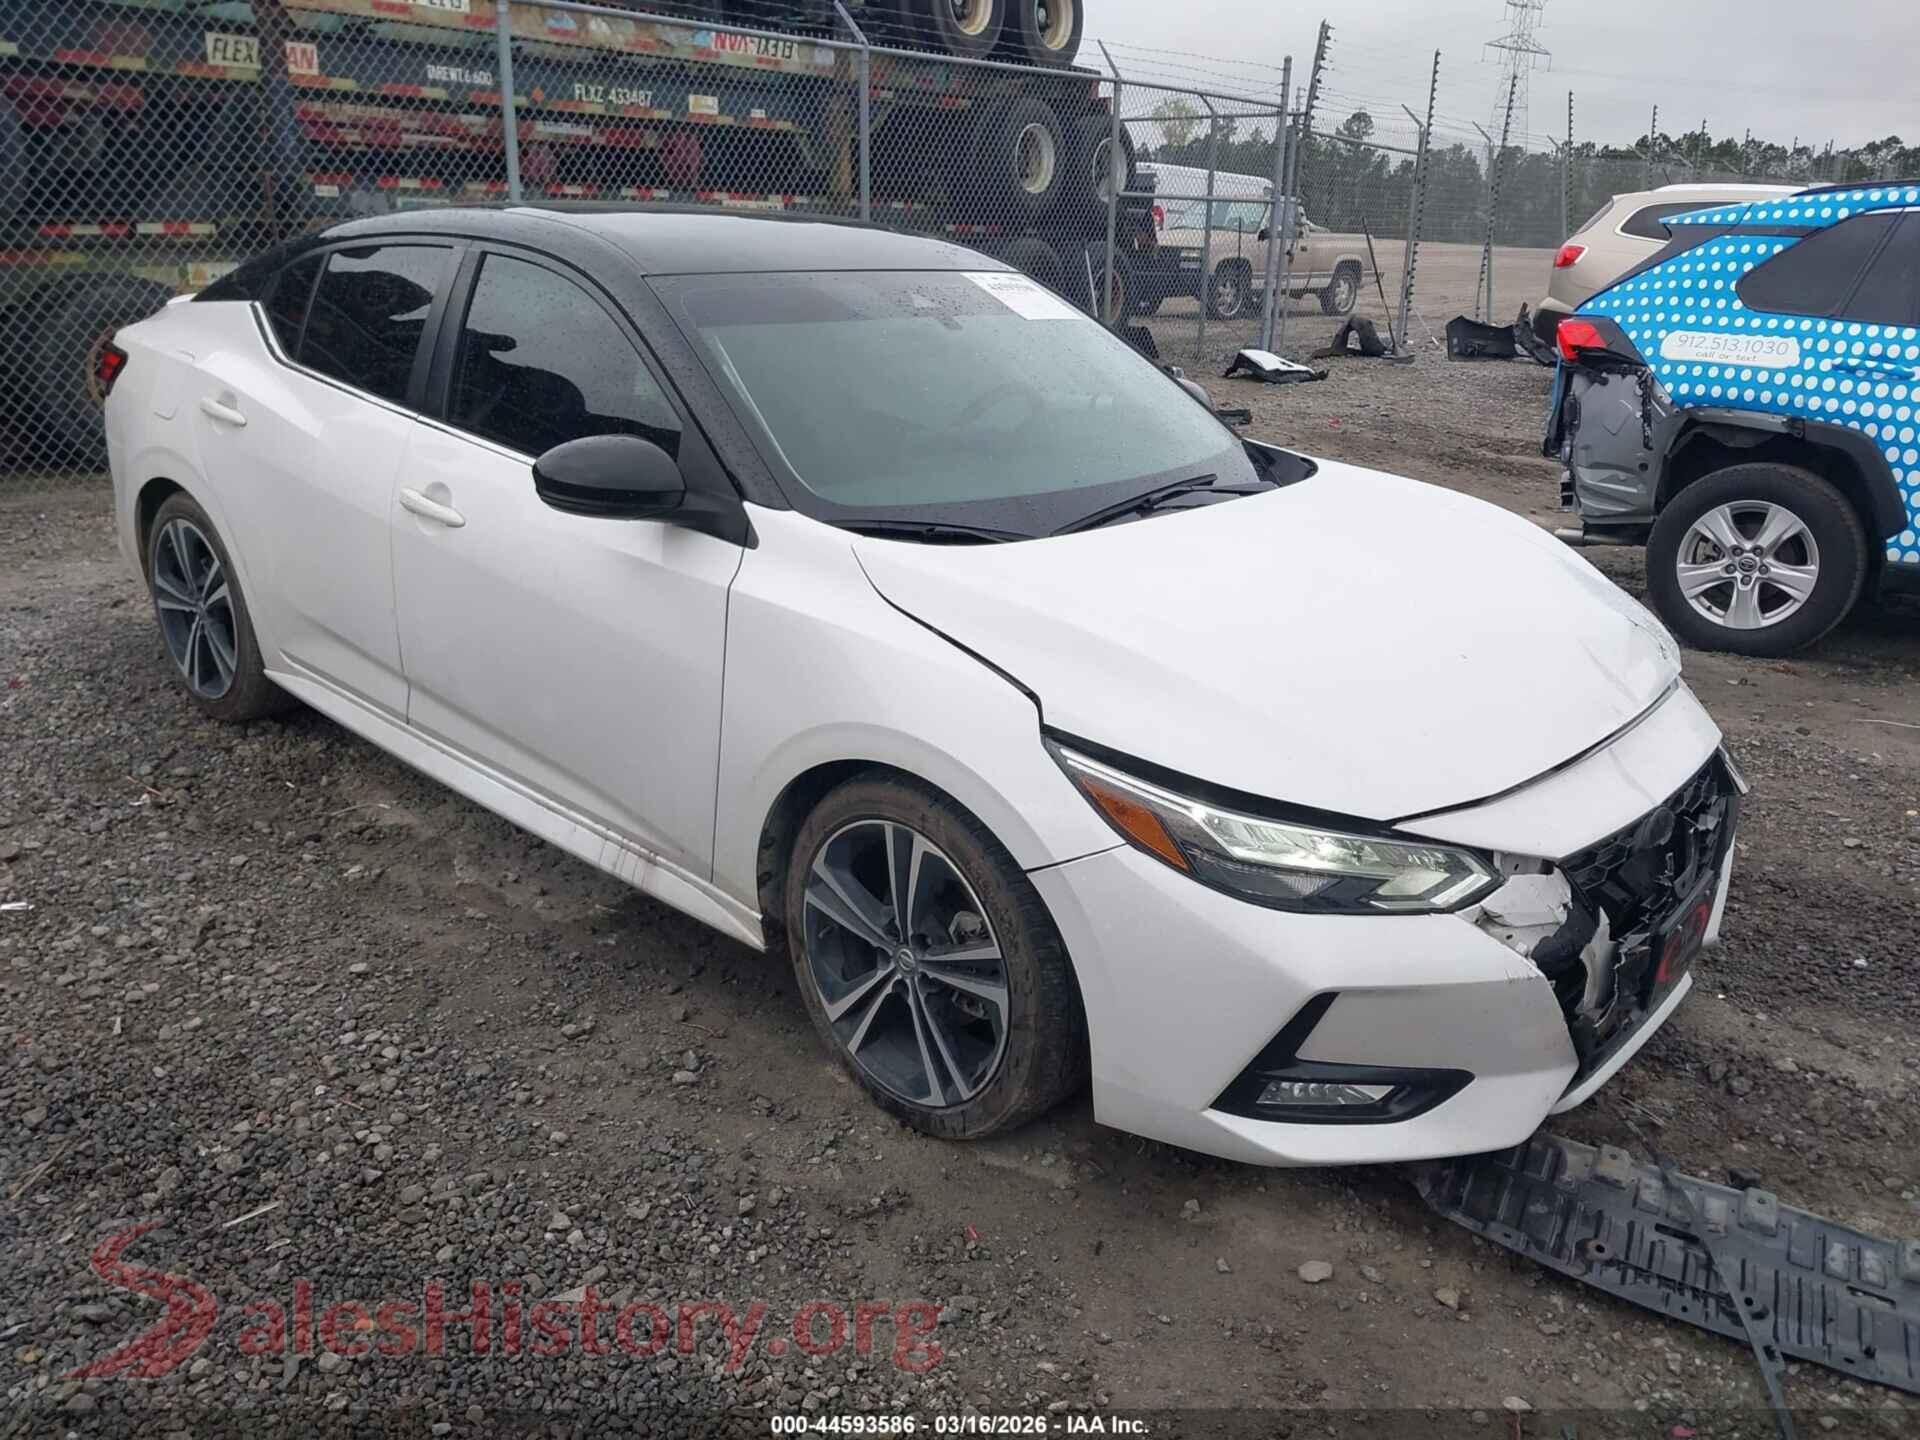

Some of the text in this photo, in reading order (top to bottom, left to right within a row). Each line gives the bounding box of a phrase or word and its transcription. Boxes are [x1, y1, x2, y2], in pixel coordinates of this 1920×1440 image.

[212, 38, 315, 69] FLEX AN
[574, 83, 653, 107] FLXZ 433487
[1678, 334, 1790, 356] 912.513.1030
[1695, 351, 1715, 359] call
[1736, 354, 1757, 362] text
